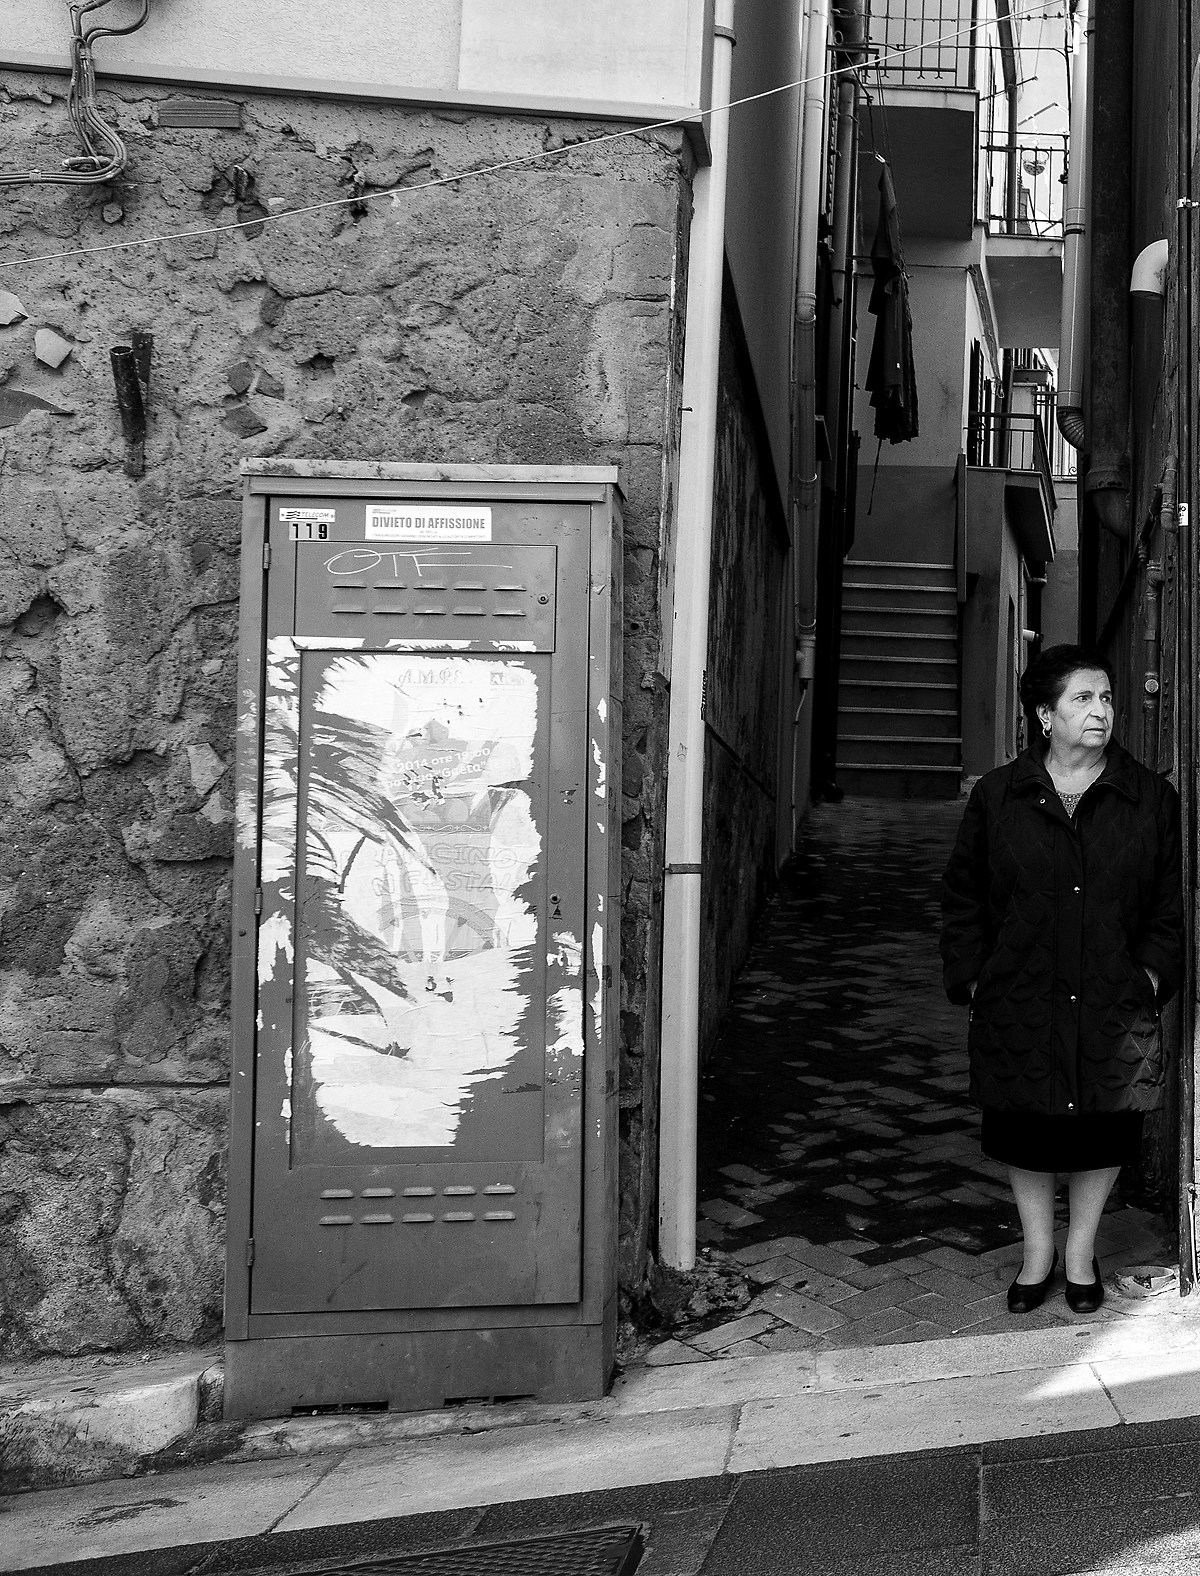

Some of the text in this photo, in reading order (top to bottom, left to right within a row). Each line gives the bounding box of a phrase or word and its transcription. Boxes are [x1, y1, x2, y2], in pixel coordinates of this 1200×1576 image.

[372, 516, 485, 529] DIVIETO DI AFFISSIONE
[292, 523, 328, 540] 119
[396, 757, 428, 771] 2014
[455, 748, 490, 760] 19:00
